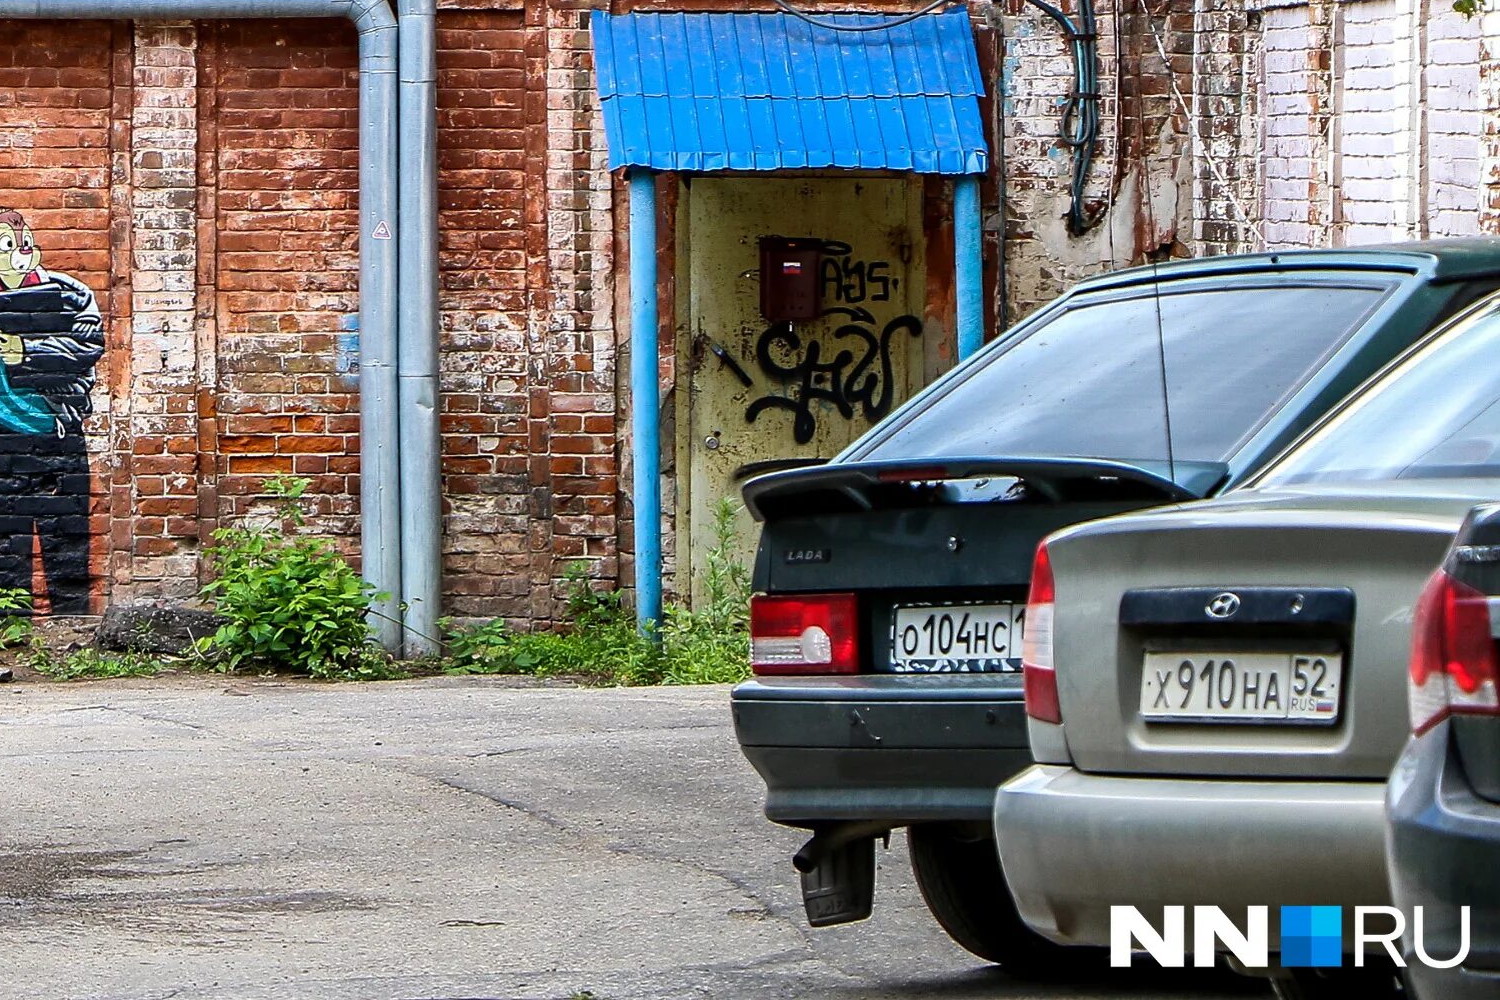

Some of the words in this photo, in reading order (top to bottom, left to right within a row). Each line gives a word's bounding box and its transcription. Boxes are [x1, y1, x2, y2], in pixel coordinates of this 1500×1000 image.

[787, 550, 823, 561] LADA
[1293, 657, 1328, 697] 52
[1291, 698, 1316, 712] RUS
